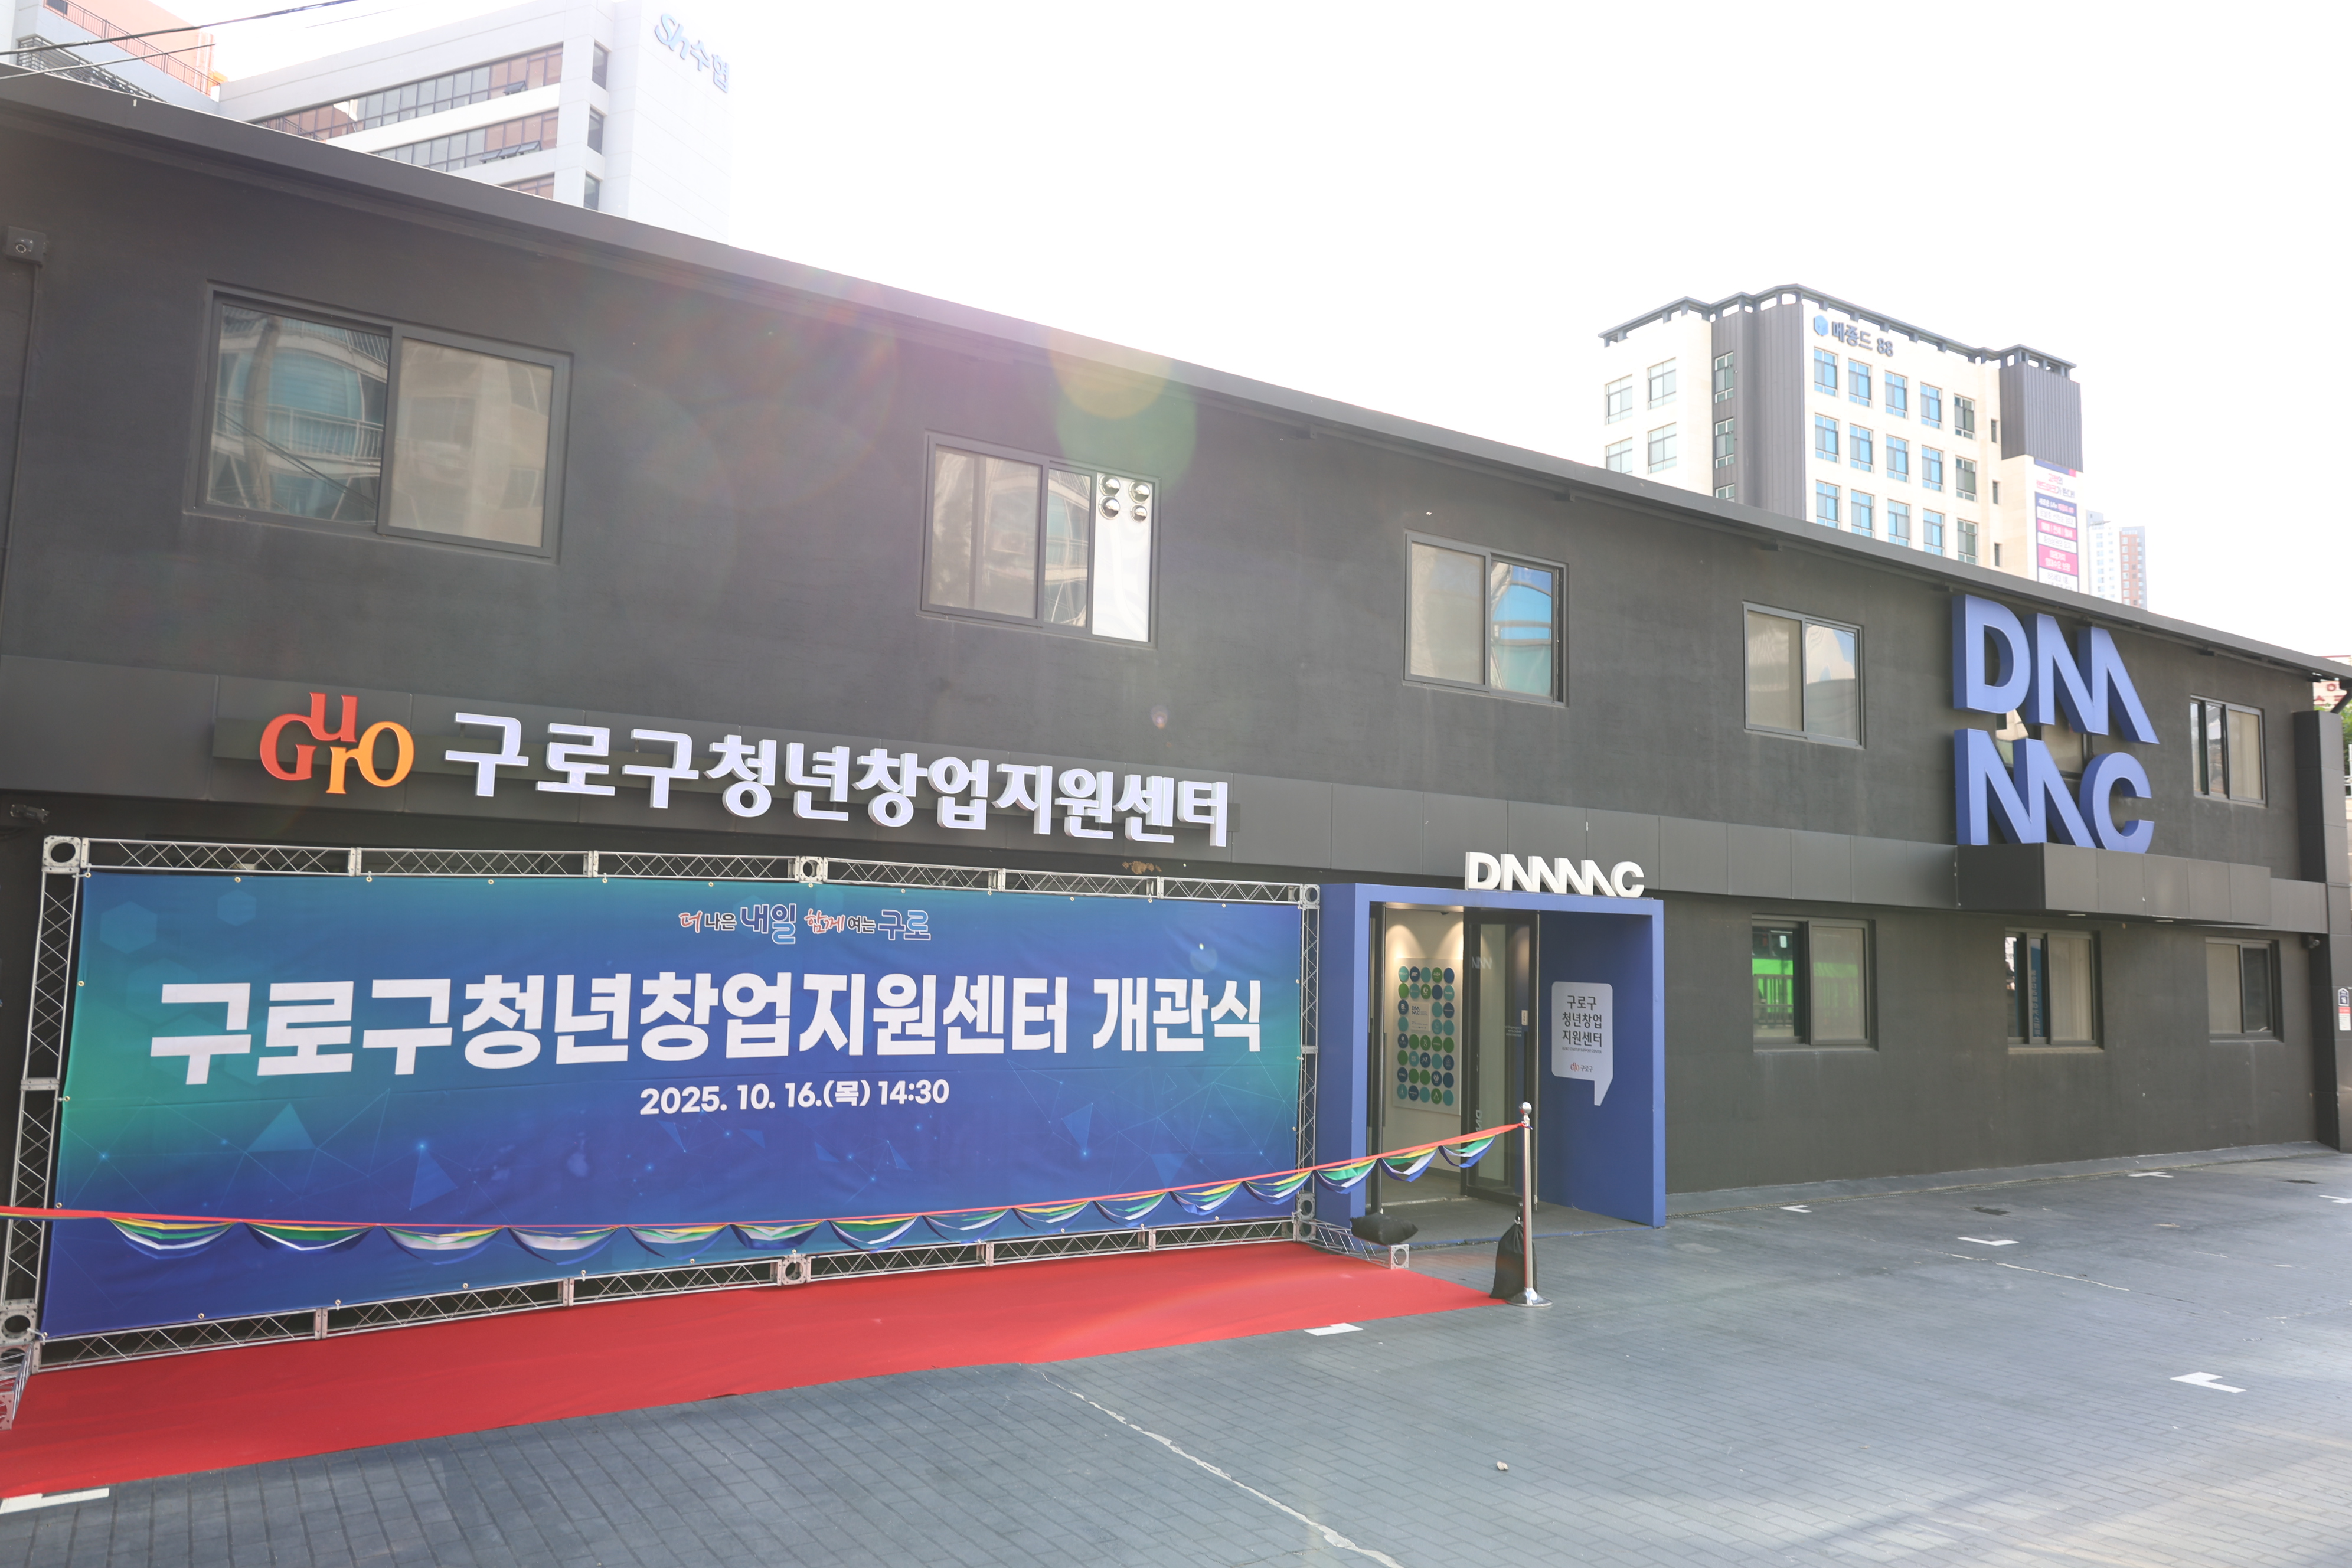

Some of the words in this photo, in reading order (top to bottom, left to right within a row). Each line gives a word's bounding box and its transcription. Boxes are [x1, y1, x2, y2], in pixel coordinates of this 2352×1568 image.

[1832, 321, 1873, 350] 메종드
[1877, 337, 1894, 357] 88
[740, 903, 797, 945] 내일
[878, 909, 932, 941] 구로
[1092, 976, 1261, 1053] 개관식
[1567, 995, 1597, 1011] 구로구
[1562, 1011, 1602, 1030] 청년창업
[1562, 1030, 1602, 1048] 지원센터
[1580, 1064, 1593, 1073] 구로구
[640, 1086, 728, 1115] 2025.
[737, 1084, 776, 1112] 10.
[785, 1079, 871, 1109] 16.(목)
[878, 1079, 950, 1105] 14:30
